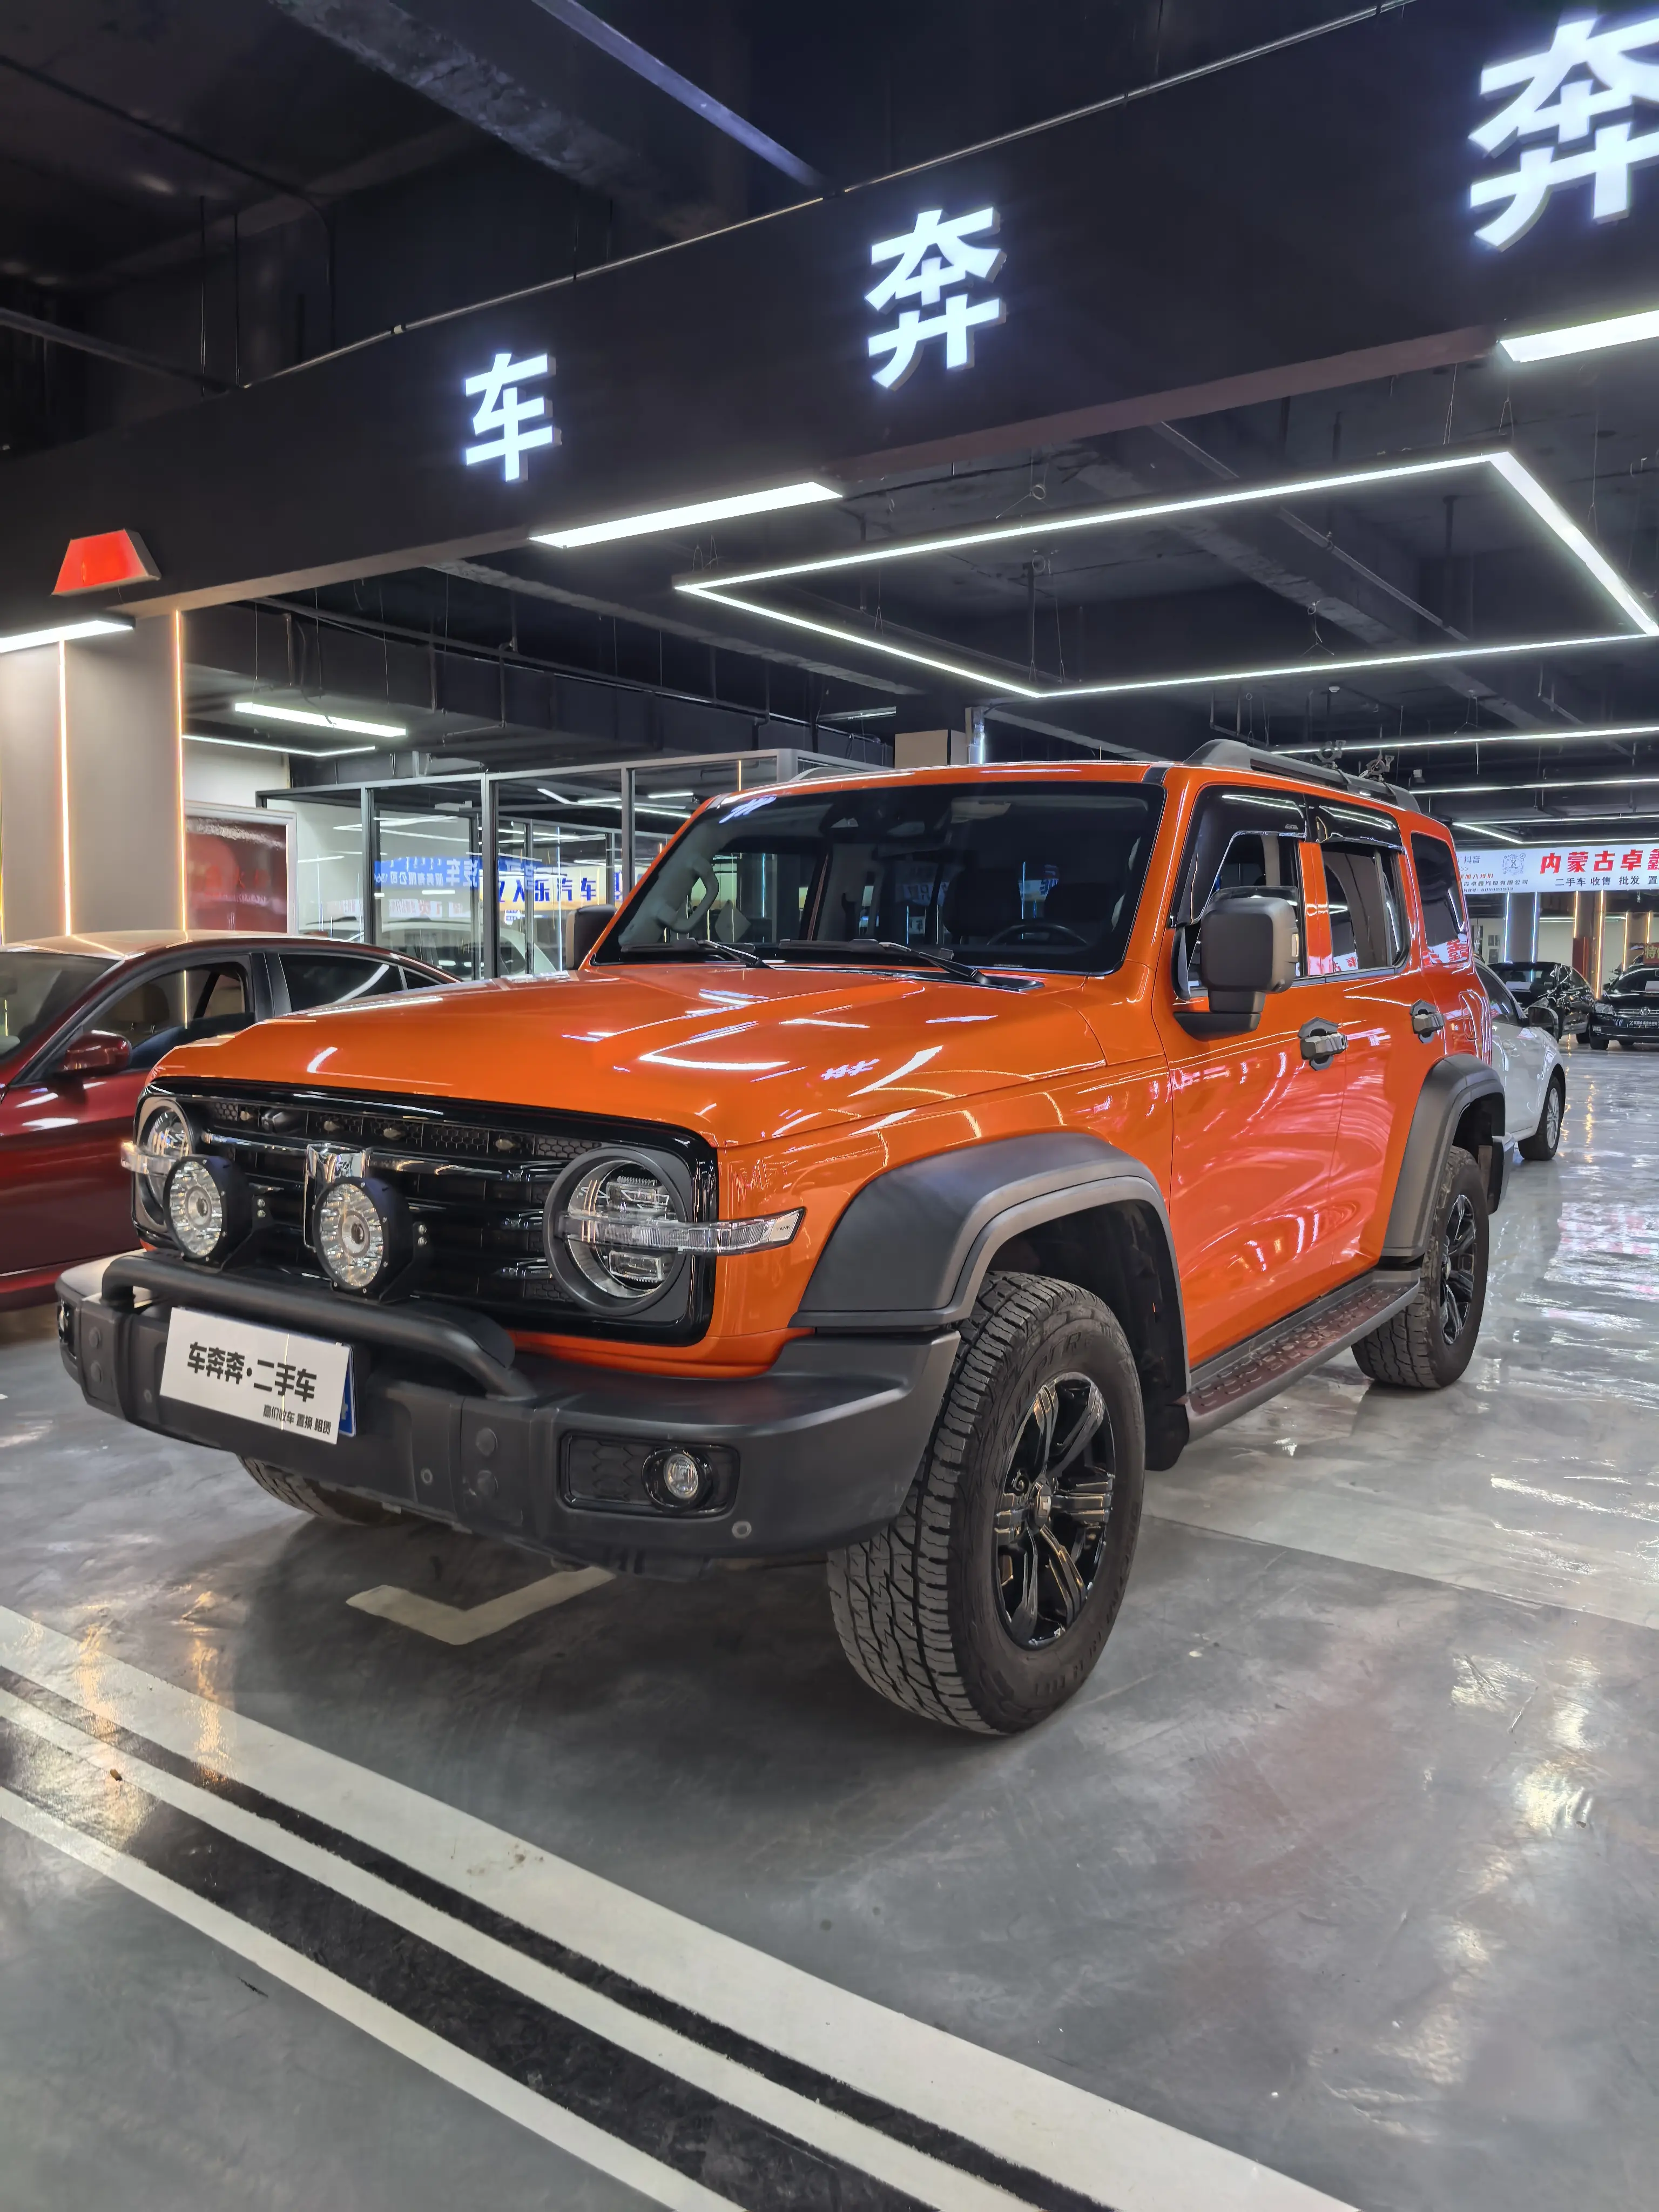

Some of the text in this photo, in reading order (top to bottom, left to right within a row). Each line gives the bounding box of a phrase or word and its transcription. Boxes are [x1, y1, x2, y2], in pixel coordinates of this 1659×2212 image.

[464, 14, 1659, 482] 车 奔 奔
[1555, 878, 1586, 887] 二手车
[1590, 876, 1611, 886] 收售
[1618, 875, 1640, 886] 批发
[1644, 945, 1659, 959] 特
